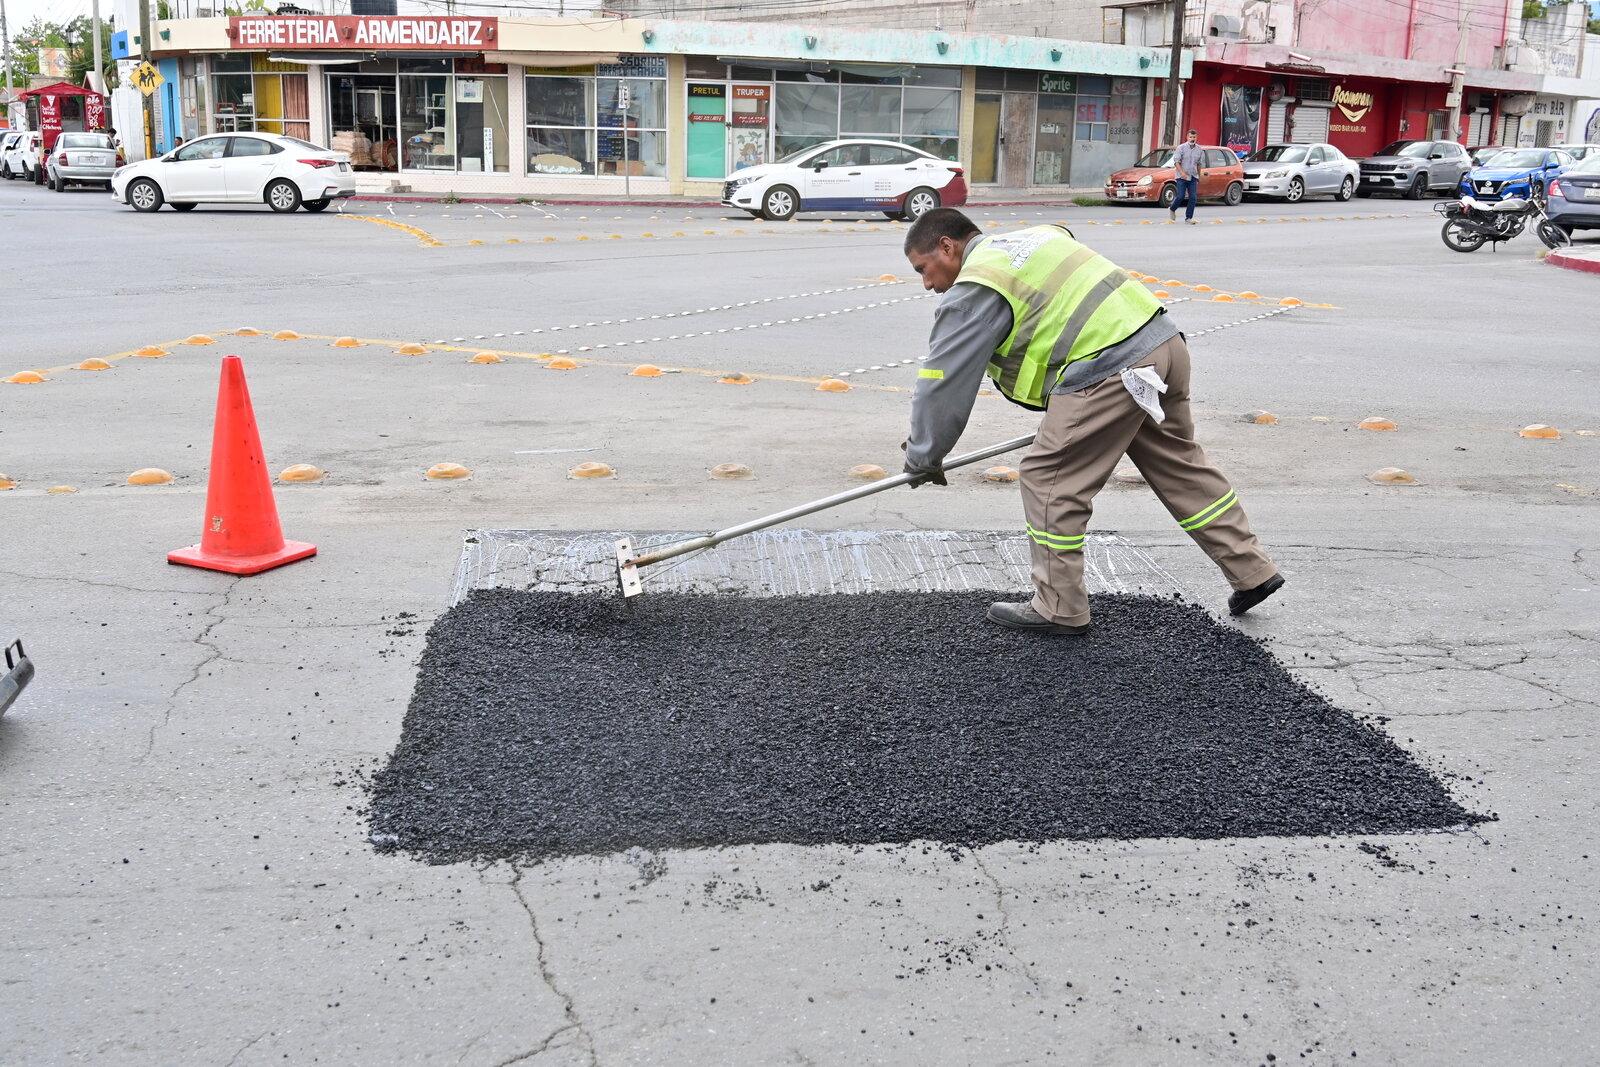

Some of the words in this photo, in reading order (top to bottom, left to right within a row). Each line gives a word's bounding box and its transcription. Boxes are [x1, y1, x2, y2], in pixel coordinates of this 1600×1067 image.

[239, 20, 339, 44] FERRETERIA
[355, 20, 482, 45] ARMENDARIZ
[693, 87, 720, 95] PRETUL
[1042, 74, 1071, 92] Sprite
[736, 88, 764, 96] TRUPER
[1078, 104, 1097, 122] SE
[1550, 99, 1564, 115] BAR
